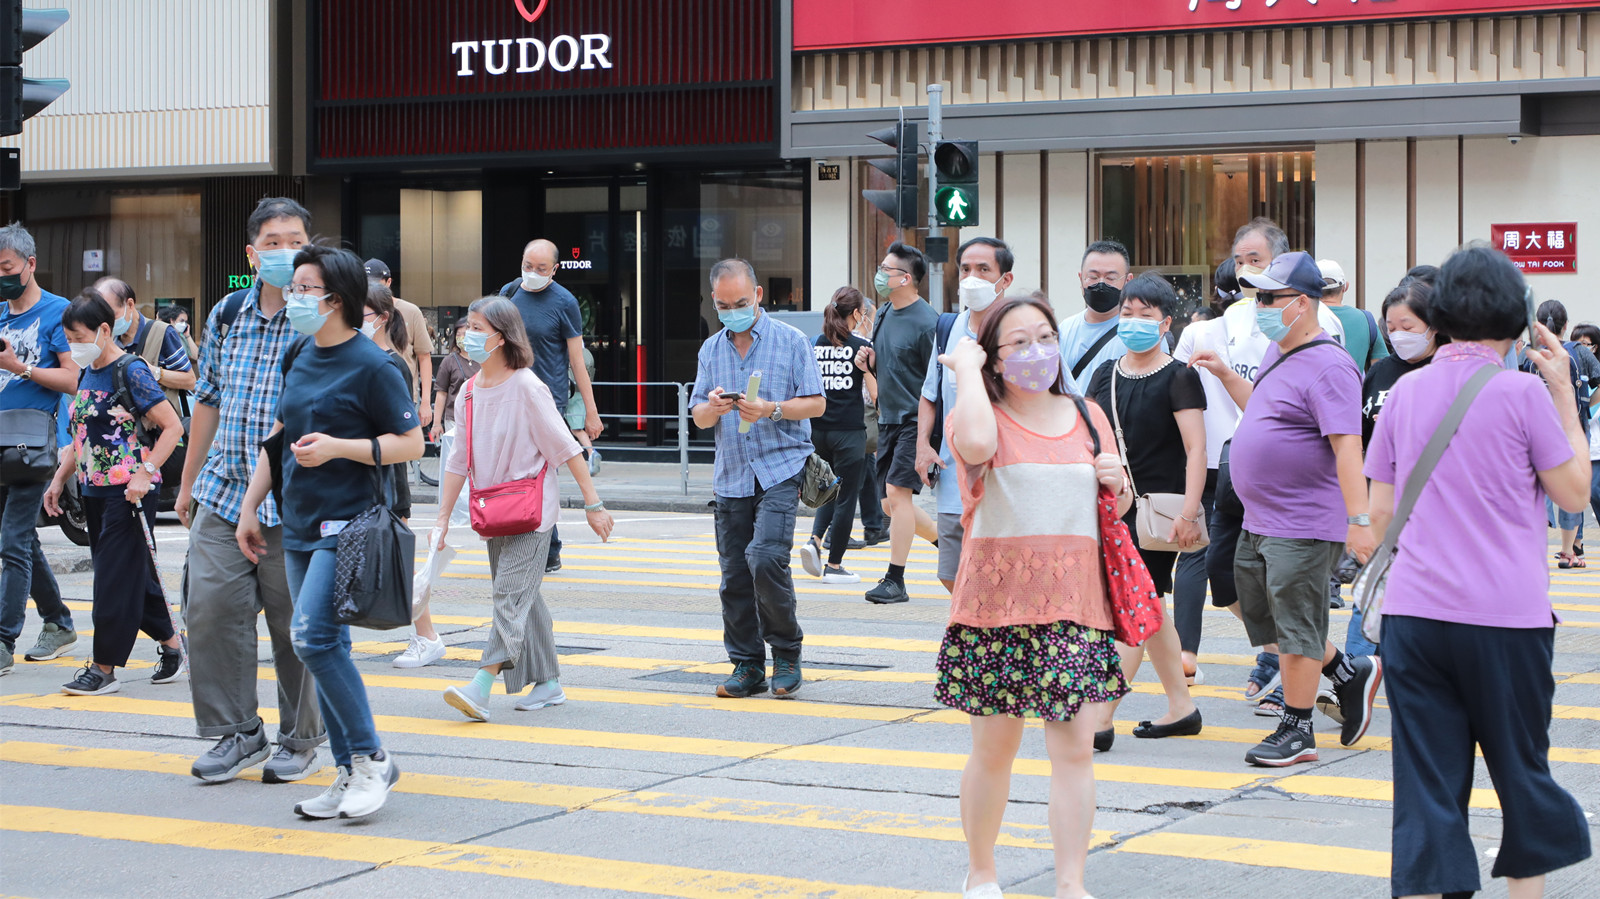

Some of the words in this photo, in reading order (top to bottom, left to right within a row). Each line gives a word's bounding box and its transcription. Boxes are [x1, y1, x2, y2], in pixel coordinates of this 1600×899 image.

[451, 33, 613, 76] TUDOR
[1503, 230, 1565, 250] 周大福
[560, 260, 592, 269] TUDOR
[1543, 260, 1564, 268] FOOK
[1230, 362, 1260, 383] SBC
